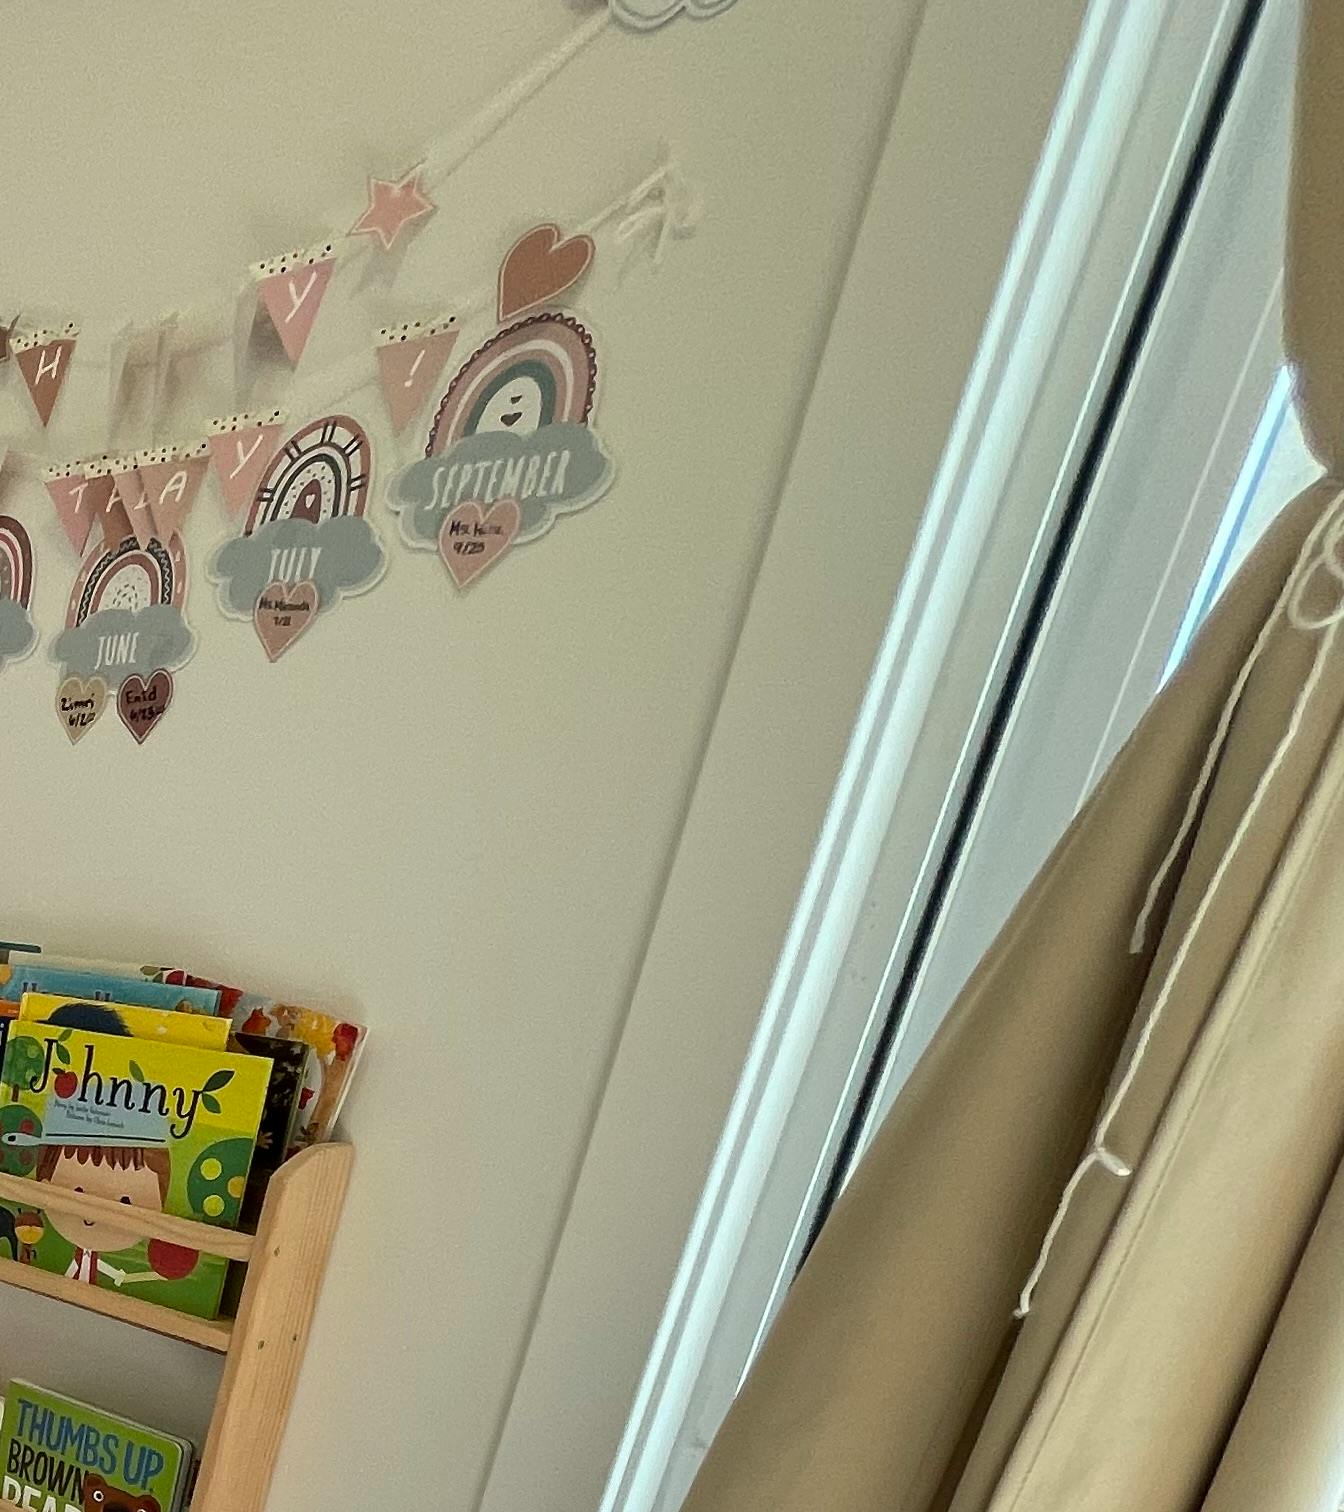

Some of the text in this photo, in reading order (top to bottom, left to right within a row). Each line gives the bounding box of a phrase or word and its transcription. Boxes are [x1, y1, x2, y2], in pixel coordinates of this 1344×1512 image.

[35, 346, 63, 386] H
[424, 450, 571, 511] SEPTEMBER
[94, 632, 139, 669] JUNE
[16, 1399, 119, 1475] THUMBS
[7, 1439, 87, 1504] BROWN
